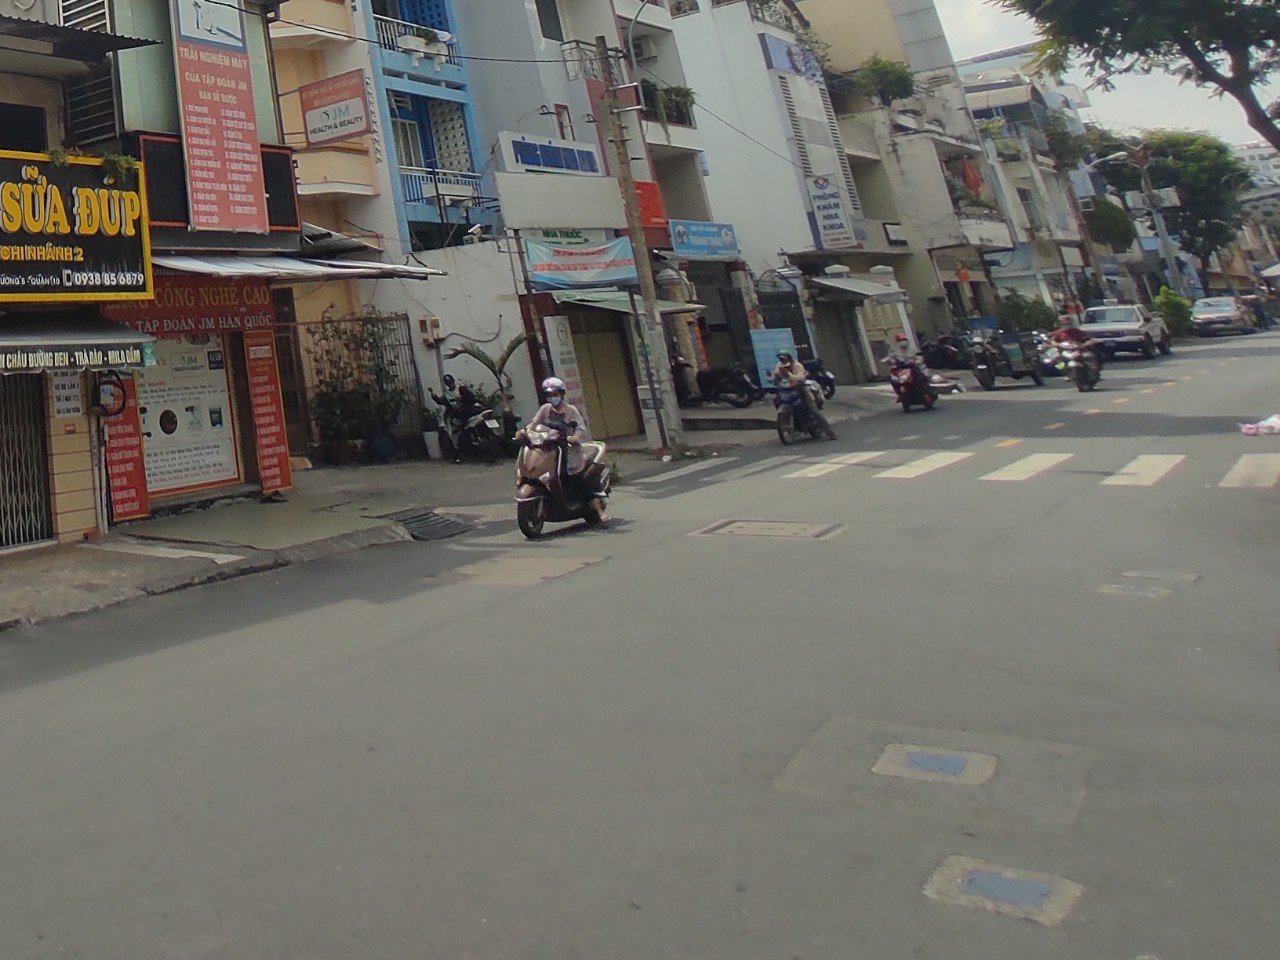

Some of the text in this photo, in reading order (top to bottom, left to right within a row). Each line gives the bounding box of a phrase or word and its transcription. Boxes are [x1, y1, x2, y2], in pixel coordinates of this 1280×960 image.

[310, 124, 333, 136] HEALTH
[339, 115, 363, 128] BEAUTY
[74, 247, 84, 261] 2
[74, 272, 101, 286] 0938
[103, 272, 117, 286] 85
[118, 272, 144, 286] 6879
[155, 282, 270, 310] CÔNG NGHỆ CAO
[136, 315, 160, 333] TẬP
[163, 315, 195, 331] ĐOÀN
[198, 318, 216, 330] JM
[219, 312, 242, 329] HÀN
[244, 311, 273, 329] QUỐC
[6, 350, 27, 368] CHÂU
[74, 349, 89, 365] TRÀ
